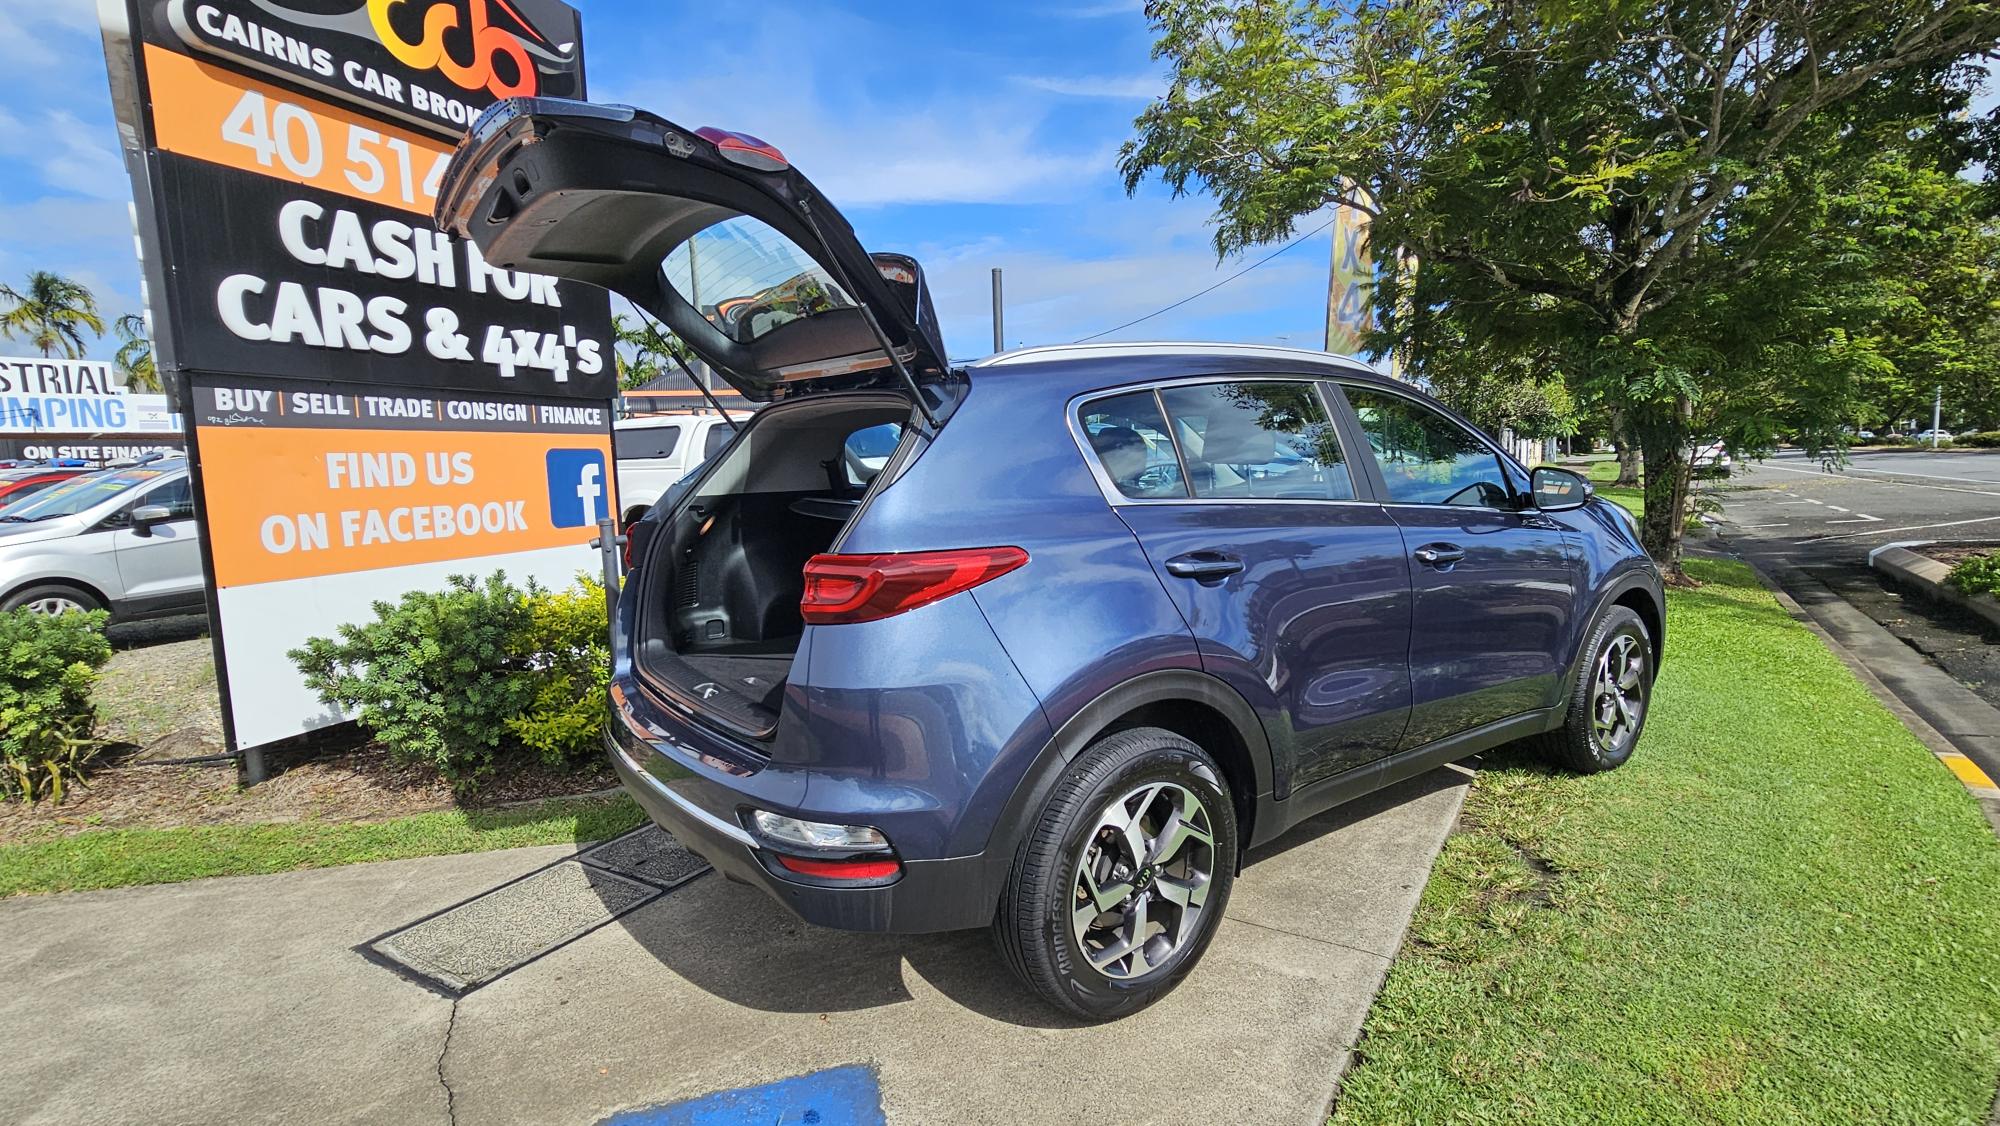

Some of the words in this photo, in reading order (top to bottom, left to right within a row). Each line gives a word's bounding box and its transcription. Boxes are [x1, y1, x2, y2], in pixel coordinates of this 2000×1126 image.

[195, 4, 334, 76] CAIRNS
[343, 61, 404, 103] CAR
[221, 89, 324, 178] 40
[278, 199, 456, 288] CASH
[217, 273, 413, 354] CARS
[425, 307, 474, 361] &
[214, 387, 272, 413] BUY
[292, 392, 350, 415] SELL
[364, 396, 433, 418] TRADE
[447, 400, 527, 422] CONSIGN
[541, 405, 601, 425] FINANCE
[23, 446, 54, 460] ON
[58, 446, 99, 459] SITE
[325, 452, 416, 489] FIND
[426, 451, 475, 486] US
[260, 512, 329, 554] ON
[341, 500, 528, 547] FACEBOOK
[1053, 851, 1073, 975] BRIDGESTONE
[1137, 869, 1150, 887] KIA
